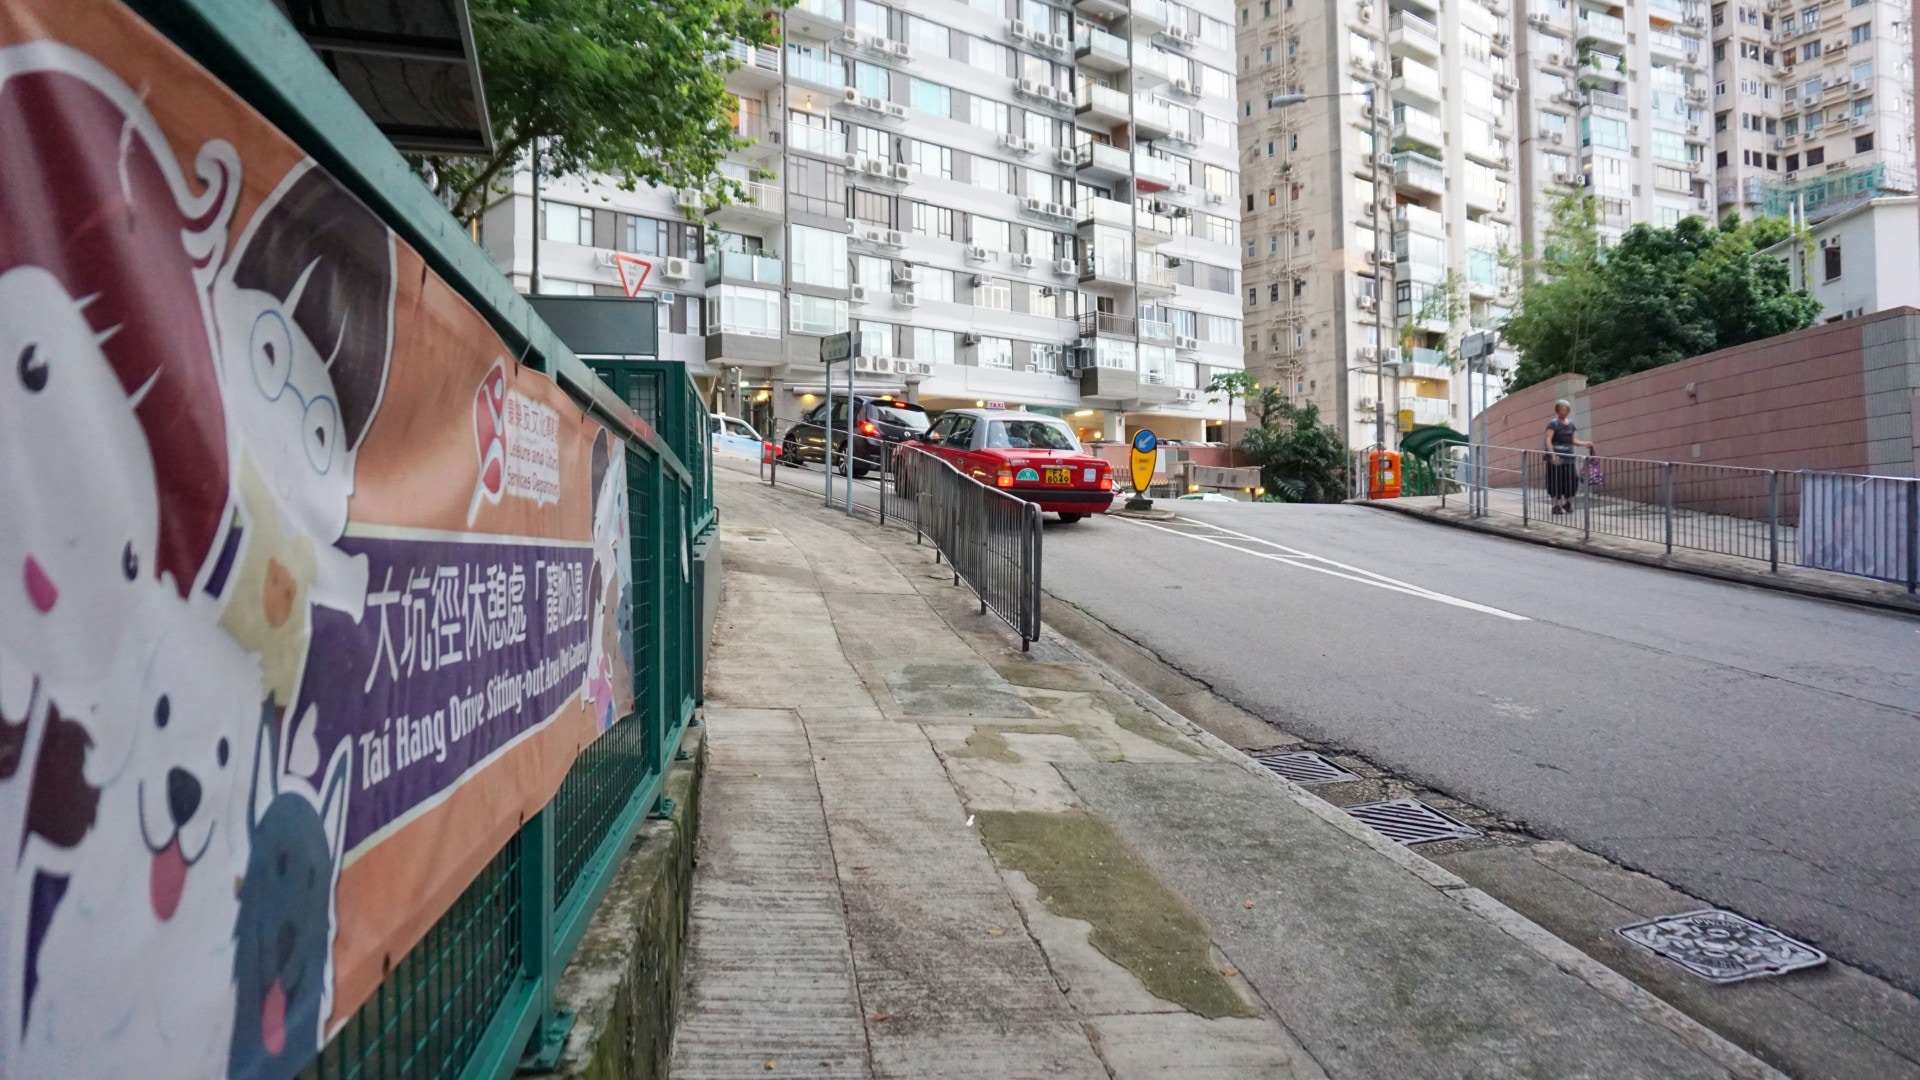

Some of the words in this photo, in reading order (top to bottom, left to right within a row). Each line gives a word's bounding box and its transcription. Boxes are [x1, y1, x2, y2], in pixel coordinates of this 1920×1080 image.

[359, 717, 391, 790] Tai
[395, 708, 447, 763] Hang
[449, 686, 484, 743] Drive
[487, 658, 545, 720] Sitting-out
